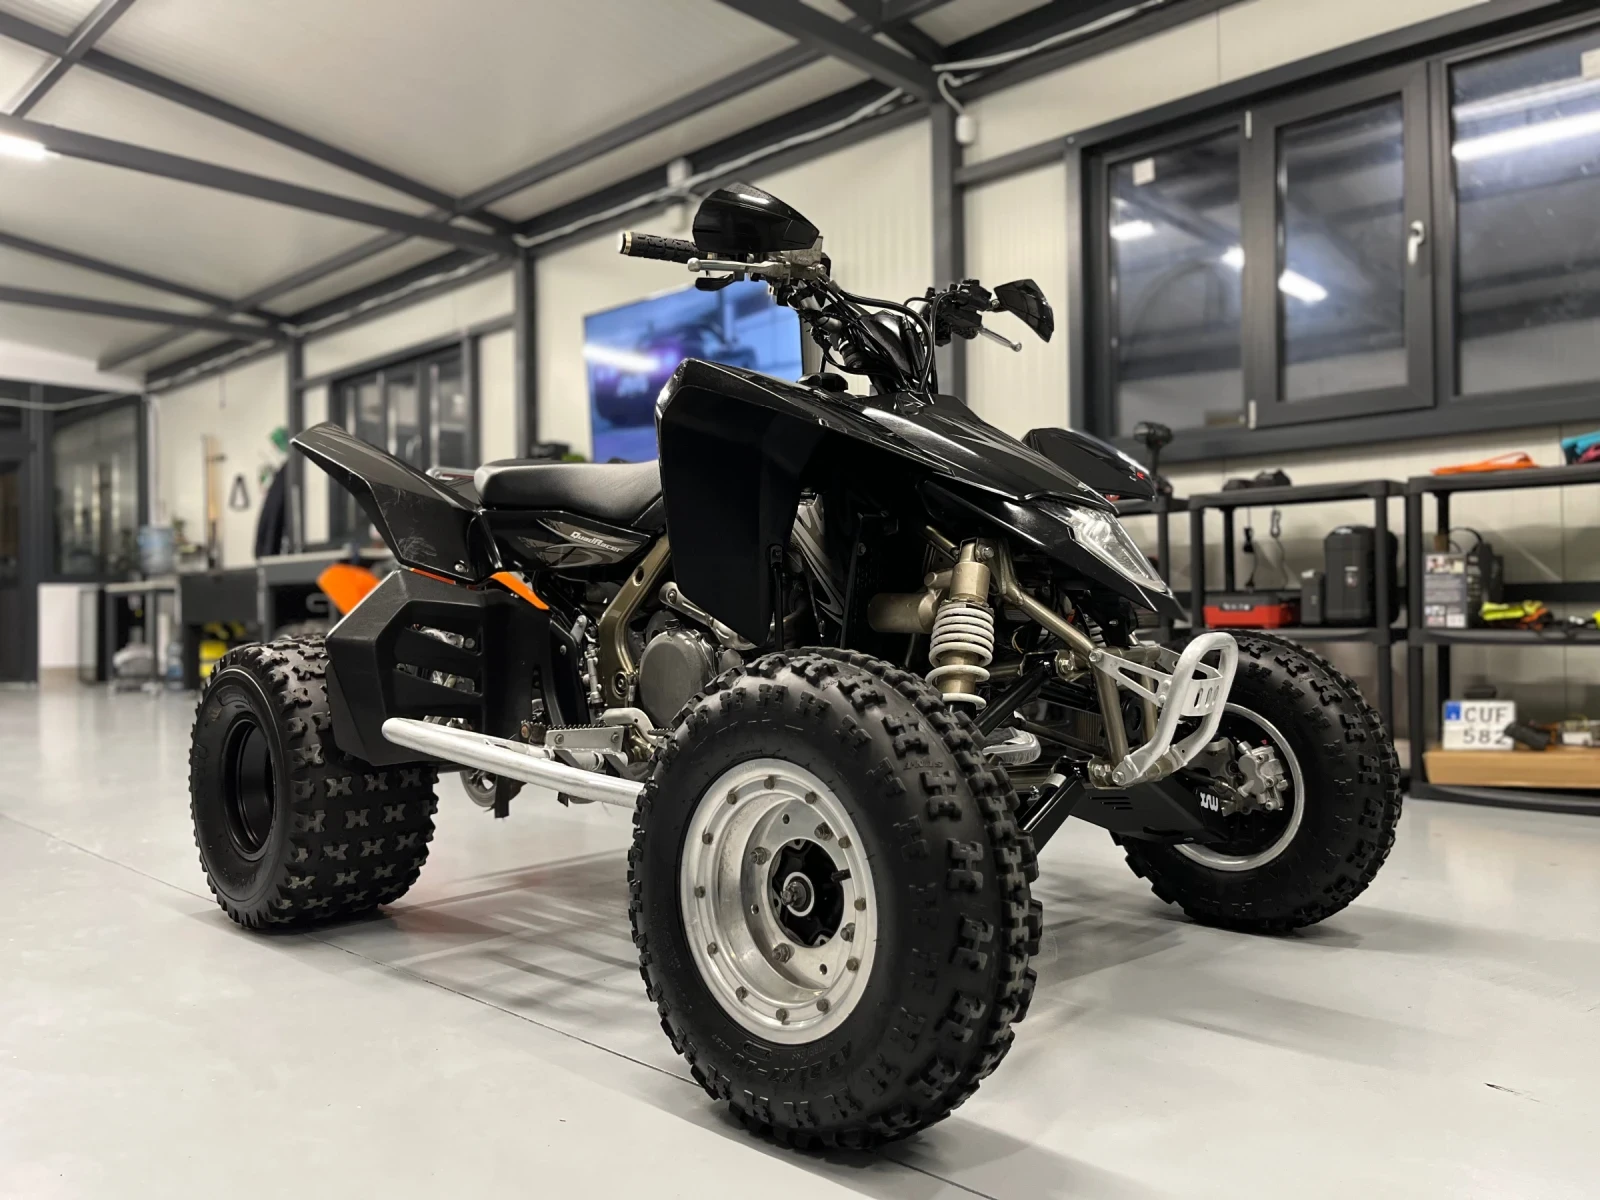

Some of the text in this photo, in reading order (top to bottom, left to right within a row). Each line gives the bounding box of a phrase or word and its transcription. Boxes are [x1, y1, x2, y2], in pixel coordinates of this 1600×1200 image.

[569, 531, 624, 553] QuadRacer
[1463, 706, 1509, 723] CUF
[1462, 728, 1507, 746] 582
